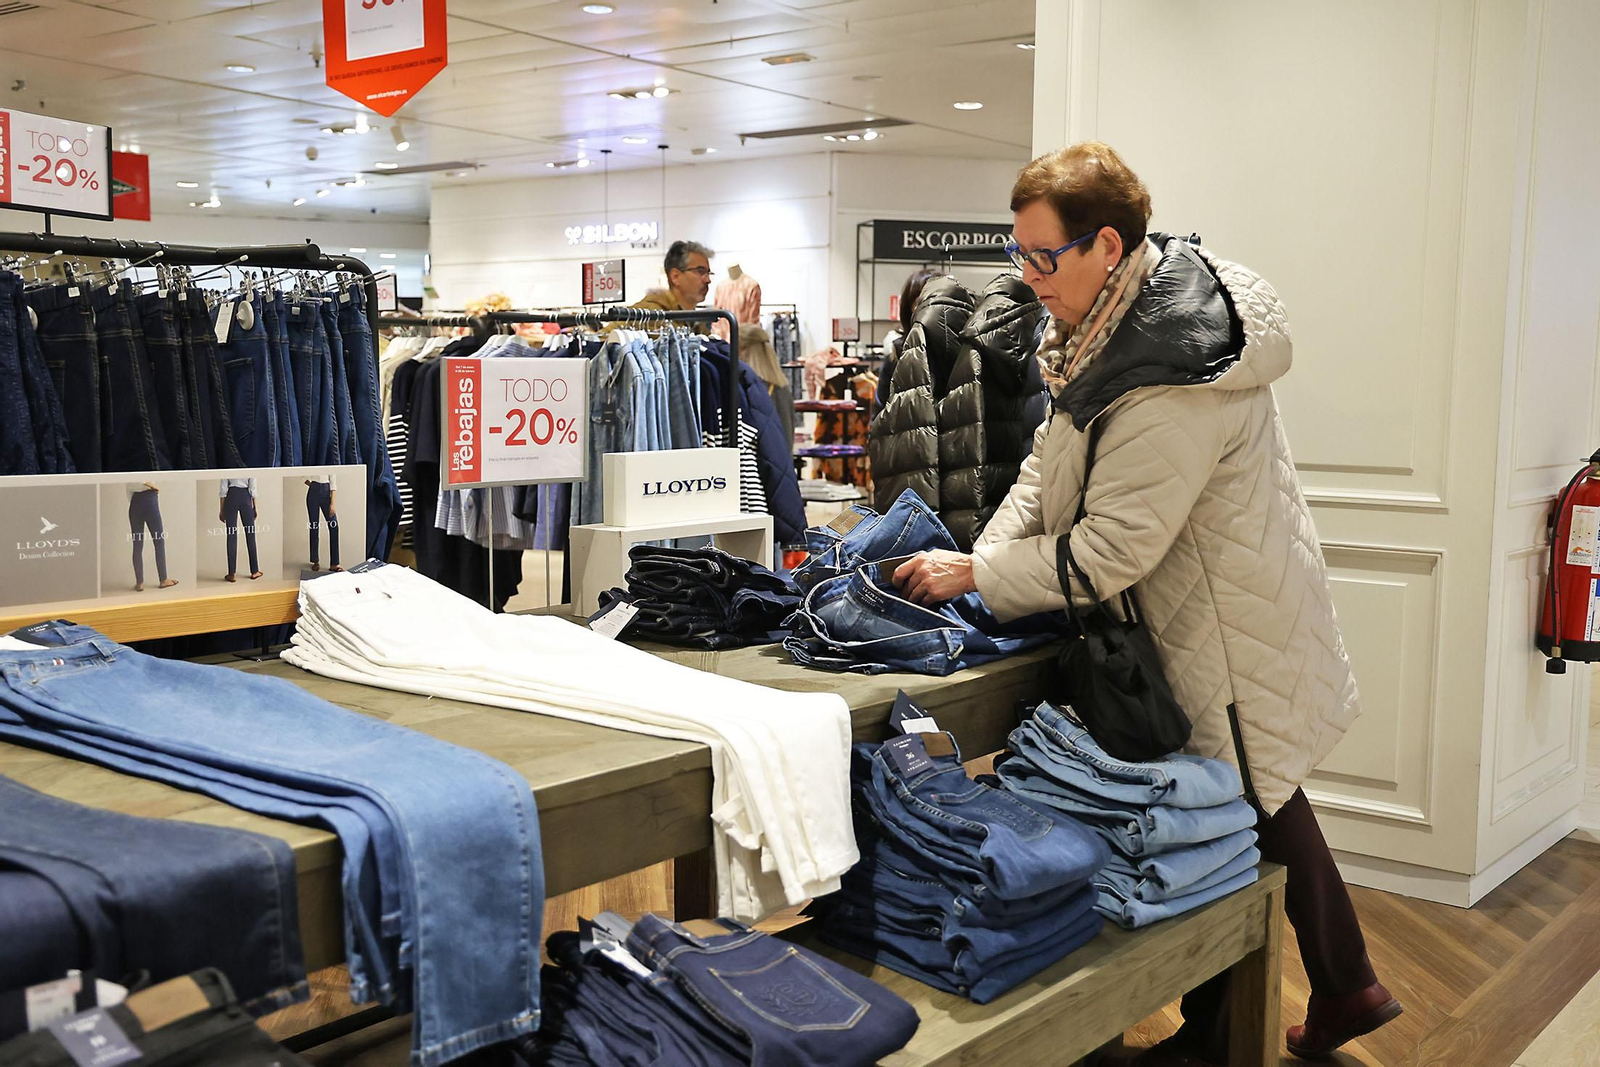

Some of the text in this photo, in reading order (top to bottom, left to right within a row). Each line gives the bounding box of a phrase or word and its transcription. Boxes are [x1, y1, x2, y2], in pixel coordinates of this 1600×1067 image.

[26, 129, 89, 157] TODO
[17, 154, 99, 191] -20%
[583, 221, 659, 244] SILBON
[499, 378, 568, 403] TODO
[454, 377, 478, 471] rebajas
[488, 408, 578, 446] -20%
[452, 452, 460, 471] Las
[643, 476, 727, 496] LLOYD'S
